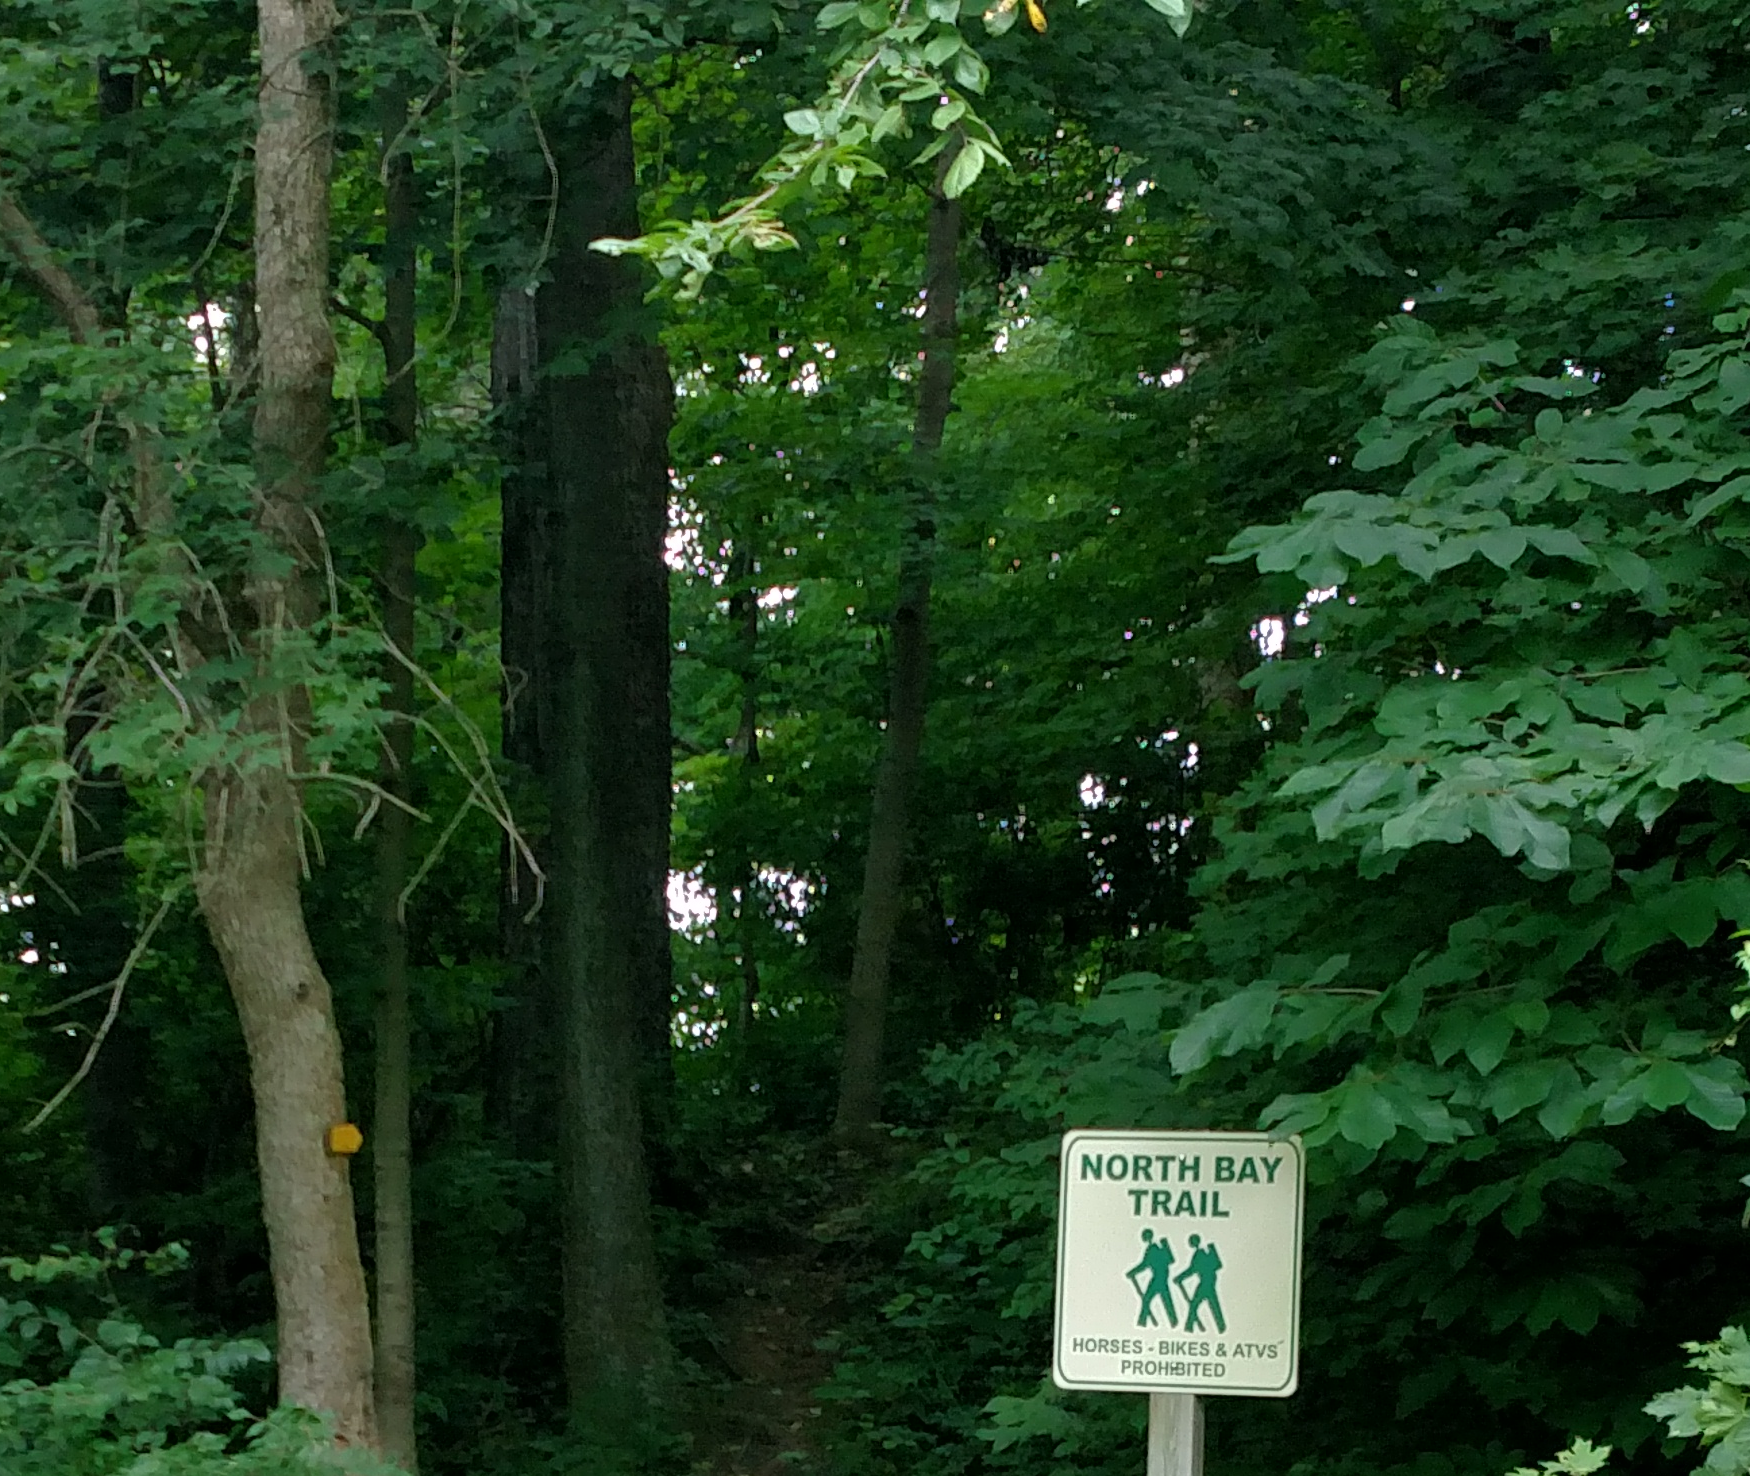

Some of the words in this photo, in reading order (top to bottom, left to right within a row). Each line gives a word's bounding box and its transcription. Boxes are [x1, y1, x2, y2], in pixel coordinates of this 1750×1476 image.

[1080, 1153, 1201, 1182] NORTH
[1214, 1156, 1283, 1183] BAY
[1128, 1189, 1230, 1217] TRAIL
[1072, 1337, 1143, 1354] HORSES
[1158, 1341, 1210, 1357] BIKES
[1216, 1342, 1228, 1357] &
[1121, 1360, 1226, 1378] PROHIBITED
